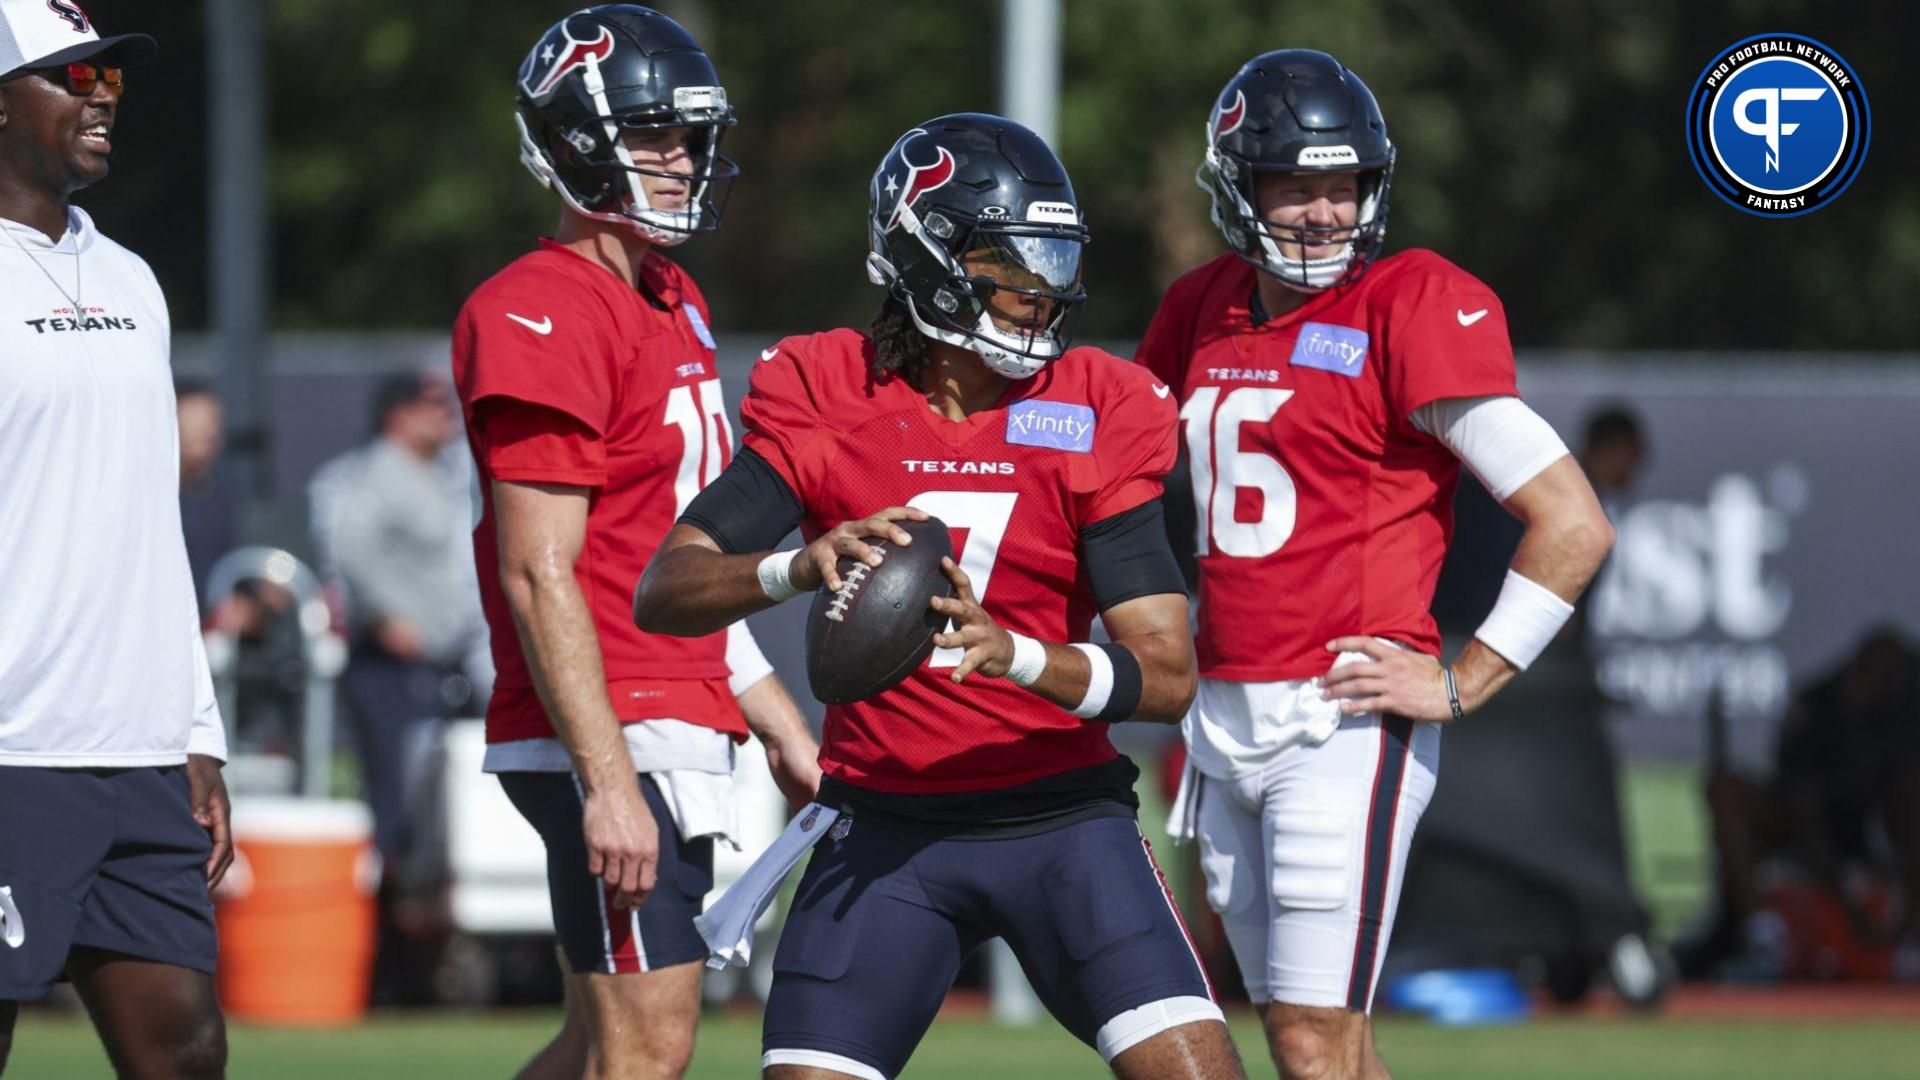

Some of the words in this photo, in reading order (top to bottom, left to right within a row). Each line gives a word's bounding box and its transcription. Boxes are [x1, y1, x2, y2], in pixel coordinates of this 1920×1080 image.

[1036, 206, 1074, 215] TEXANS
[52, 307, 104, 315] HOUTON
[24, 317, 136, 334] TEXANS
[1207, 368, 1279, 382] TEXANS
[1010, 410, 1090, 442] xfinity
[901, 460, 1015, 475] TEXANS
[1180, 387, 1297, 558] 16
[905, 490, 1019, 668] 7
